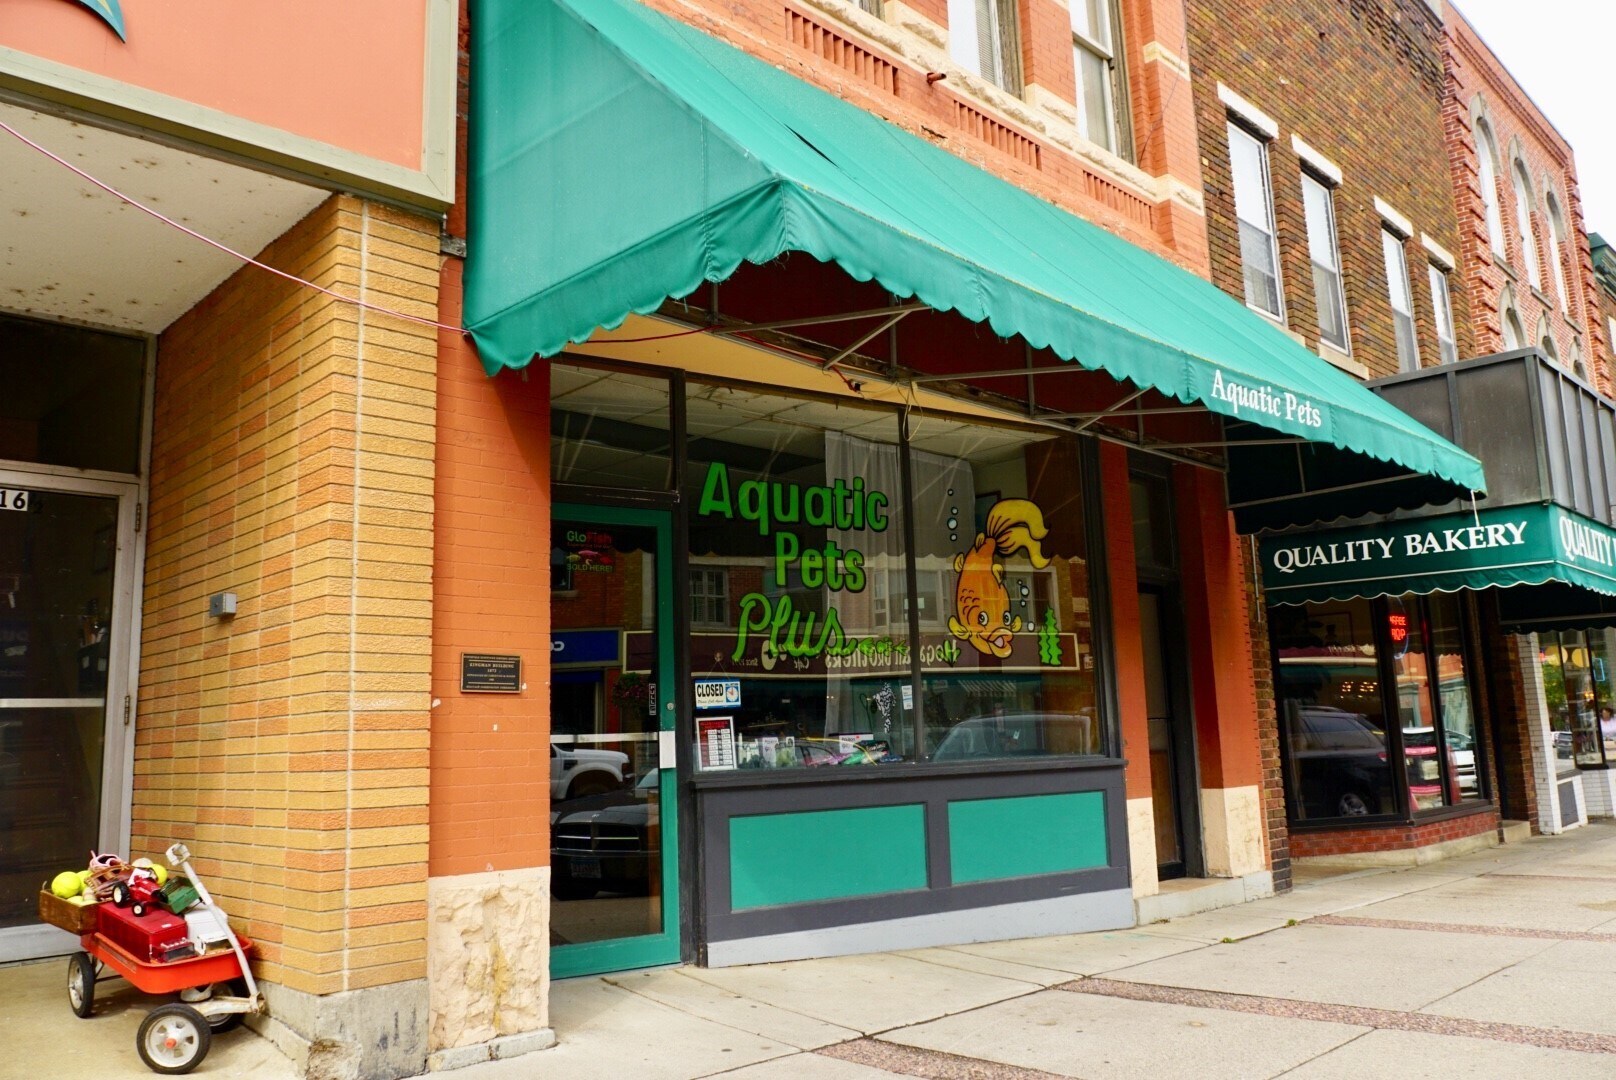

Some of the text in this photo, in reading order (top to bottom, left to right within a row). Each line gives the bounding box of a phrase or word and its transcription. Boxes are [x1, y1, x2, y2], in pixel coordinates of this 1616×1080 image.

[1211, 369, 1322, 428] Aquatic Pets
[698, 461, 889, 536] Aquatic
[775, 531, 867, 593] Pets
[1273, 521, 1528, 574] QUALITY BAKERY
[1559, 515, 1613, 567] QUALITY
[731, 592, 858, 663] Plus
[696, 684, 724, 697] CLOSED
